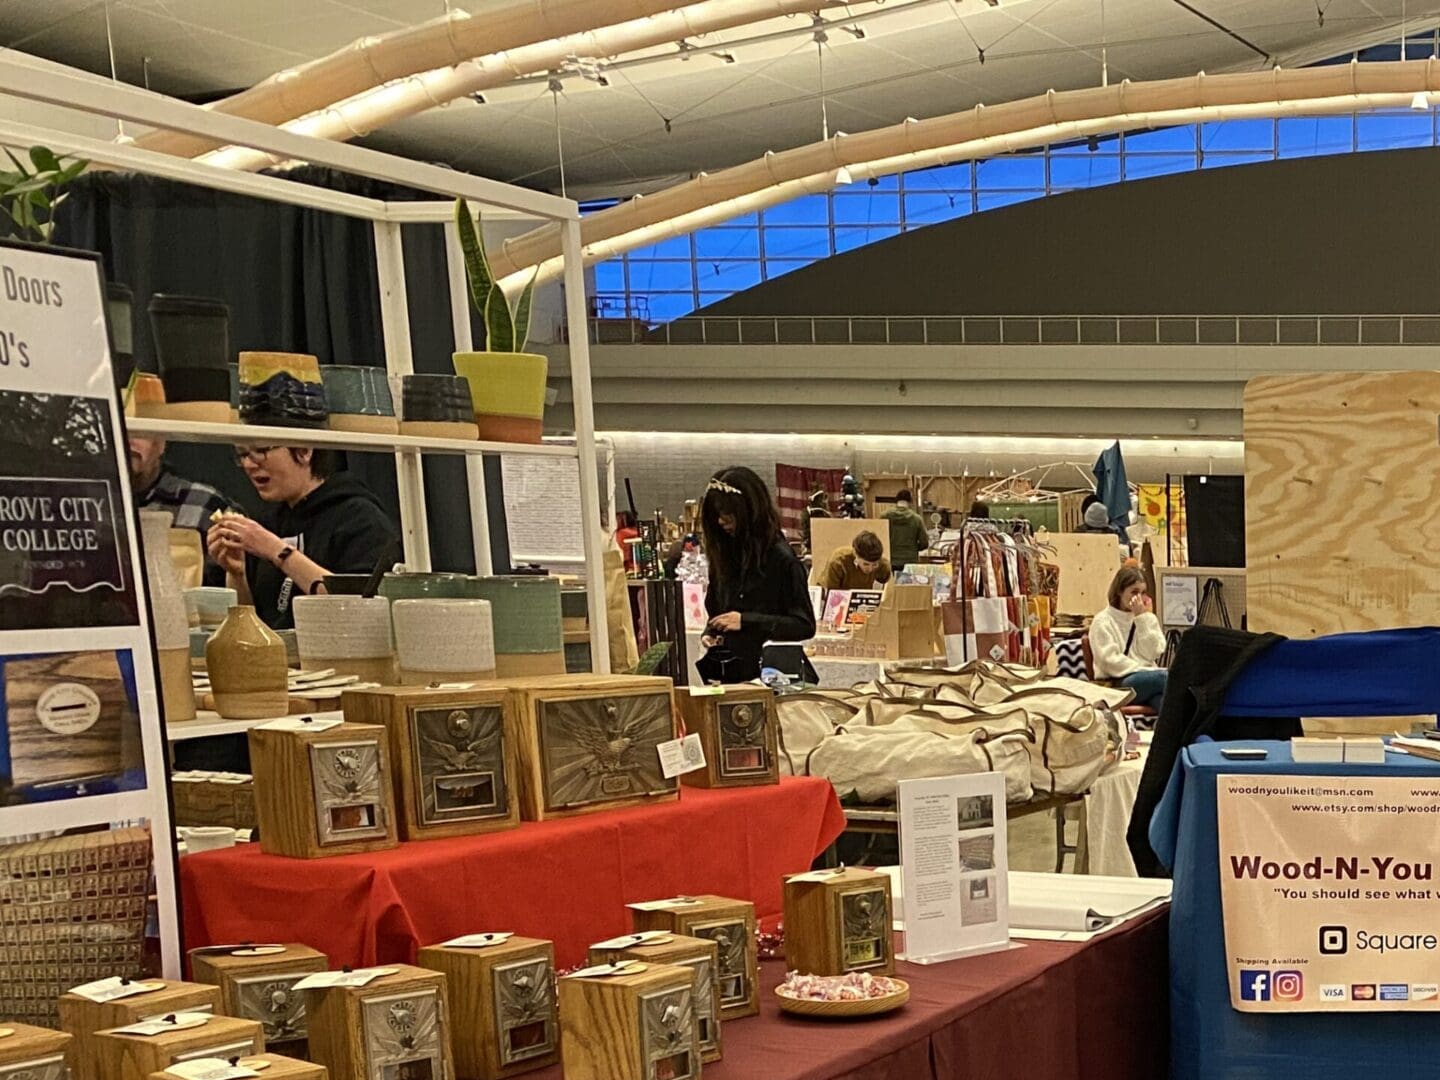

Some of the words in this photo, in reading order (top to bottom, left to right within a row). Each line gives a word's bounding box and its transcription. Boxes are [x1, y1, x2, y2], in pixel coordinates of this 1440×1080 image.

[3, 266, 63, 307] Doors
[60, 497, 104, 522] CITY
[3, 529, 98, 551] COLLEGE
[1228, 785, 1374, 797] woodnyoulikeit@msn.com
[1230, 855, 1432, 881] Wood-N-You
[1274, 888, 1307, 899] "You
[1312, 888, 1360, 899] should
[1365, 891, 1391, 899] see
[1395, 889, 1431, 899] what
[1356, 930, 1438, 954] Square
[1236, 957, 1270, 965] Shipping
[1272, 957, 1309, 965] Available
[1323, 988, 1344, 997] VISA
